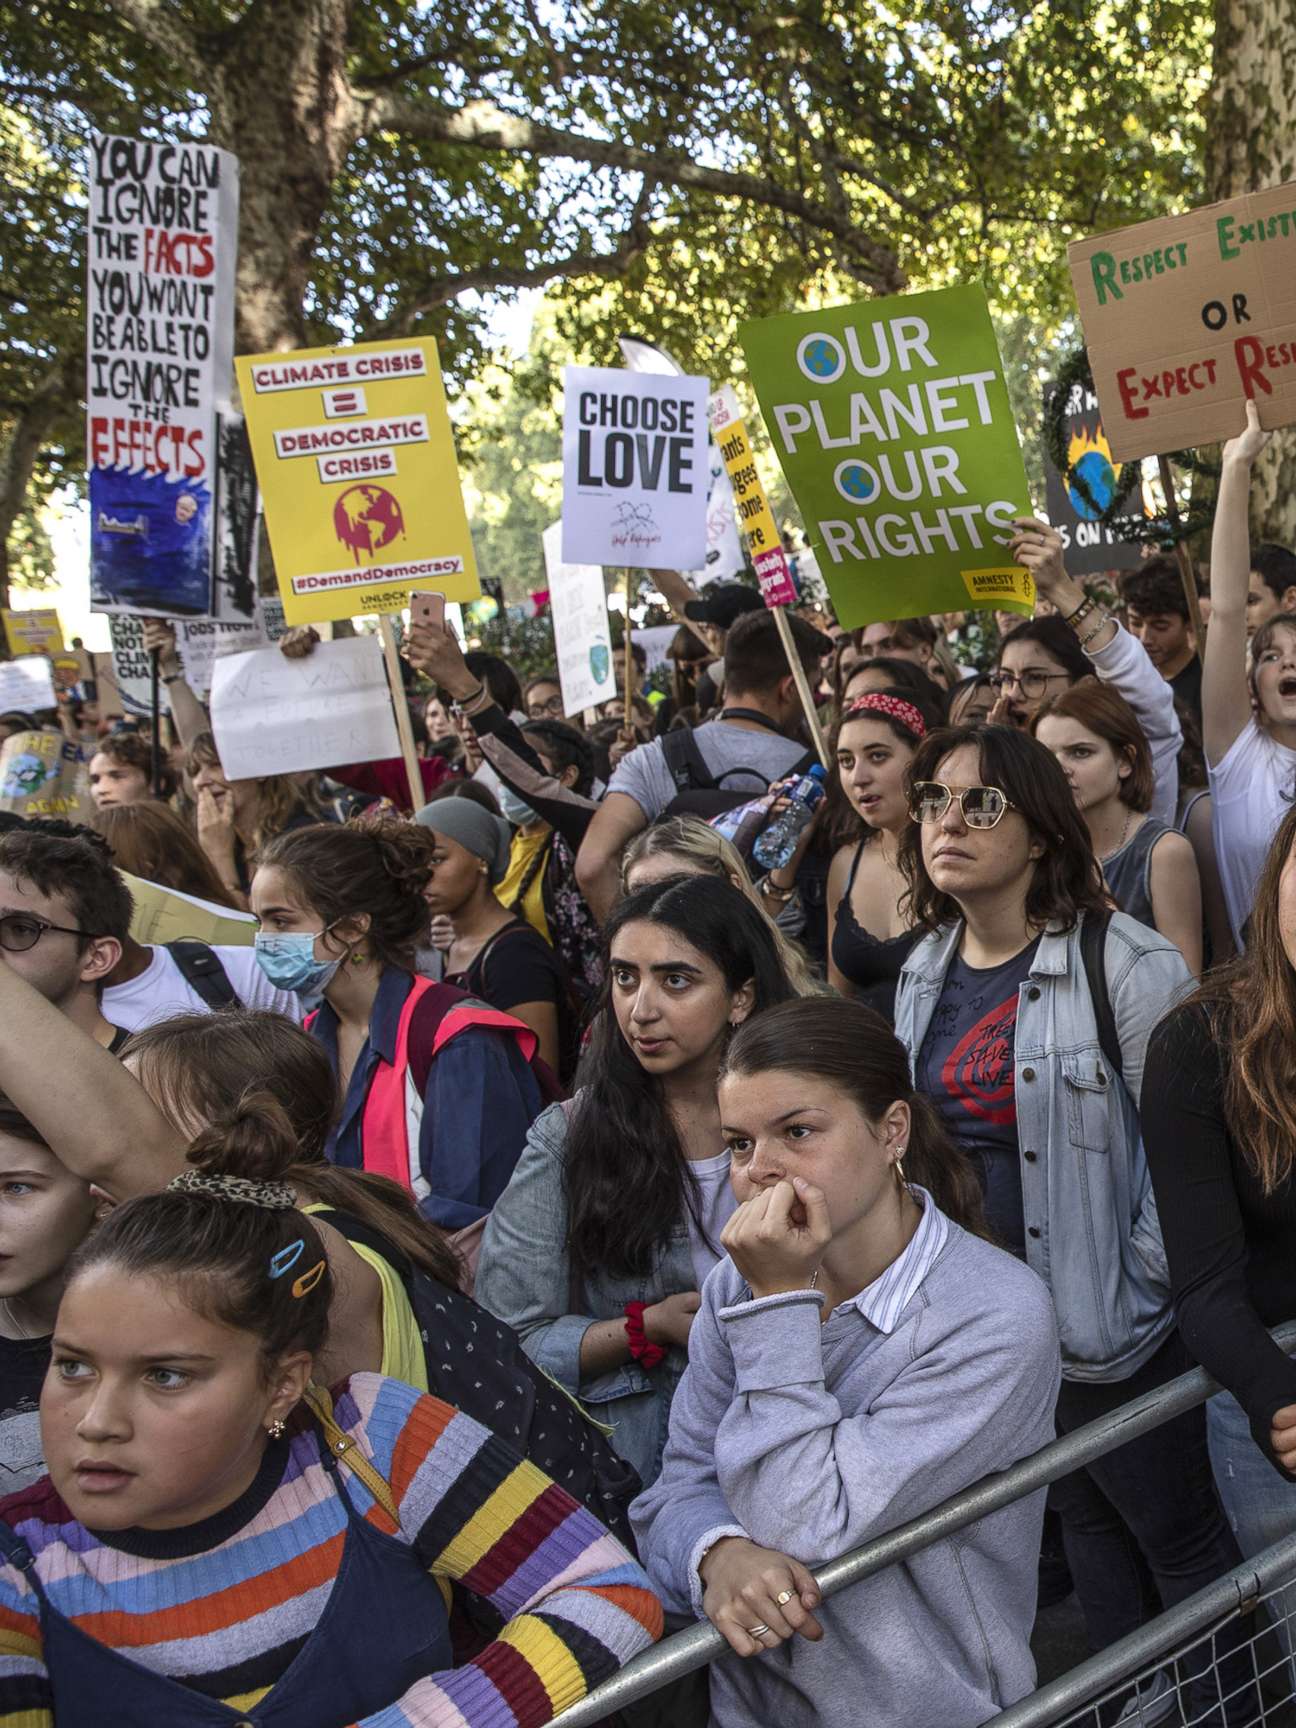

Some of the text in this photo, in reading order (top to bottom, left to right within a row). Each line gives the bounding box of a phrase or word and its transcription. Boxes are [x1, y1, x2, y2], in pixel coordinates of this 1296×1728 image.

[90, 135, 220, 188] YOU CAN
[96, 179, 208, 233] IGNORE
[92, 226, 215, 278] THE FACTS
[1090, 242, 1188, 305] RESPECT
[92, 268, 143, 316] YOU
[1201, 293, 1251, 331] OR
[92, 313, 210, 360] BE ABLE TO
[796, 316, 939, 385] OUR
[91, 353, 201, 408] IGNORE
[256, 354, 424, 386] CLIMATE CRISIS
[1116, 358, 1216, 420] EXPECT
[129, 403, 171, 424] THE
[578, 391, 695, 434] CHOOSE
[772, 369, 1000, 455] PLANET
[91, 416, 206, 477] EFFECTS
[280, 421, 423, 452] DEMOCRATIC
[720, 433, 745, 463] ants
[324, 453, 393, 476] CRISIS
[577, 428, 694, 494] LOVE
[833, 445, 967, 506] OUR
[816, 500, 1018, 565] RIGHTS
[296, 559, 460, 589] #DemandDemocracy
[360, 591, 406, 604] UNLOCK
[973, 574, 1014, 586] AMNESTY
[112, 623, 145, 636] CHA
[118, 666, 152, 679] CHA
